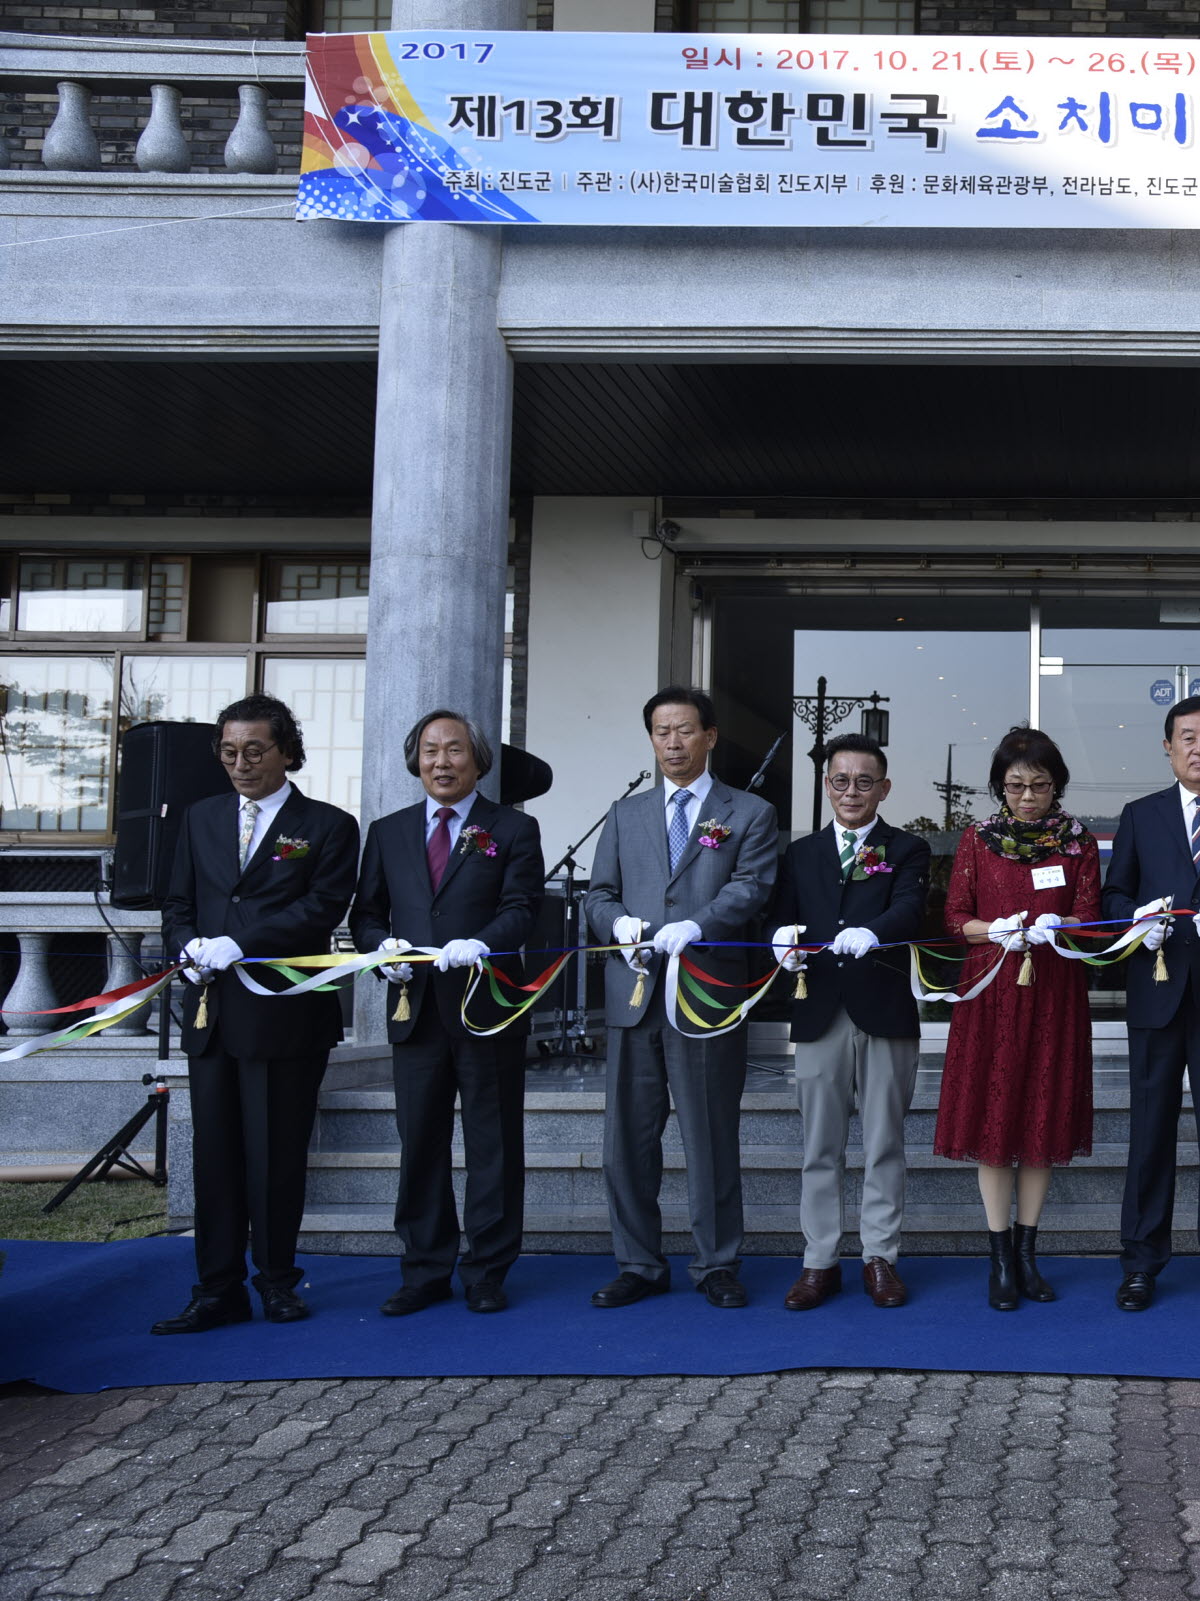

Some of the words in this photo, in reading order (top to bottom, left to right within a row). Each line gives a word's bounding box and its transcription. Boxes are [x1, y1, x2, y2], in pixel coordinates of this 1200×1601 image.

[403, 44, 493, 62] 2017
[683, 48, 740, 68] 일시
[778, 50, 859, 71] 2017.
[875, 51, 918, 71] 10.
[932, 50, 1034, 72] 21.(토)
[1088, 52, 1195, 75] 26.(목)
[449, 96, 614, 138] 제13회
[651, 91, 946, 147] 대한민국
[446, 172, 480, 191] 주최
[500, 171, 551, 191] 진도군
[577, 172, 611, 191] 주관
[631, 172, 769, 193] (사)한국미술협회
[778, 174, 847, 193] 진도지부
[870, 175, 903, 193] 후원
[923, 176, 1053, 196] 문화체육관광부,
[1062, 176, 1138, 197] 전라남도,
[1154, 687, 1172, 697] ADT
